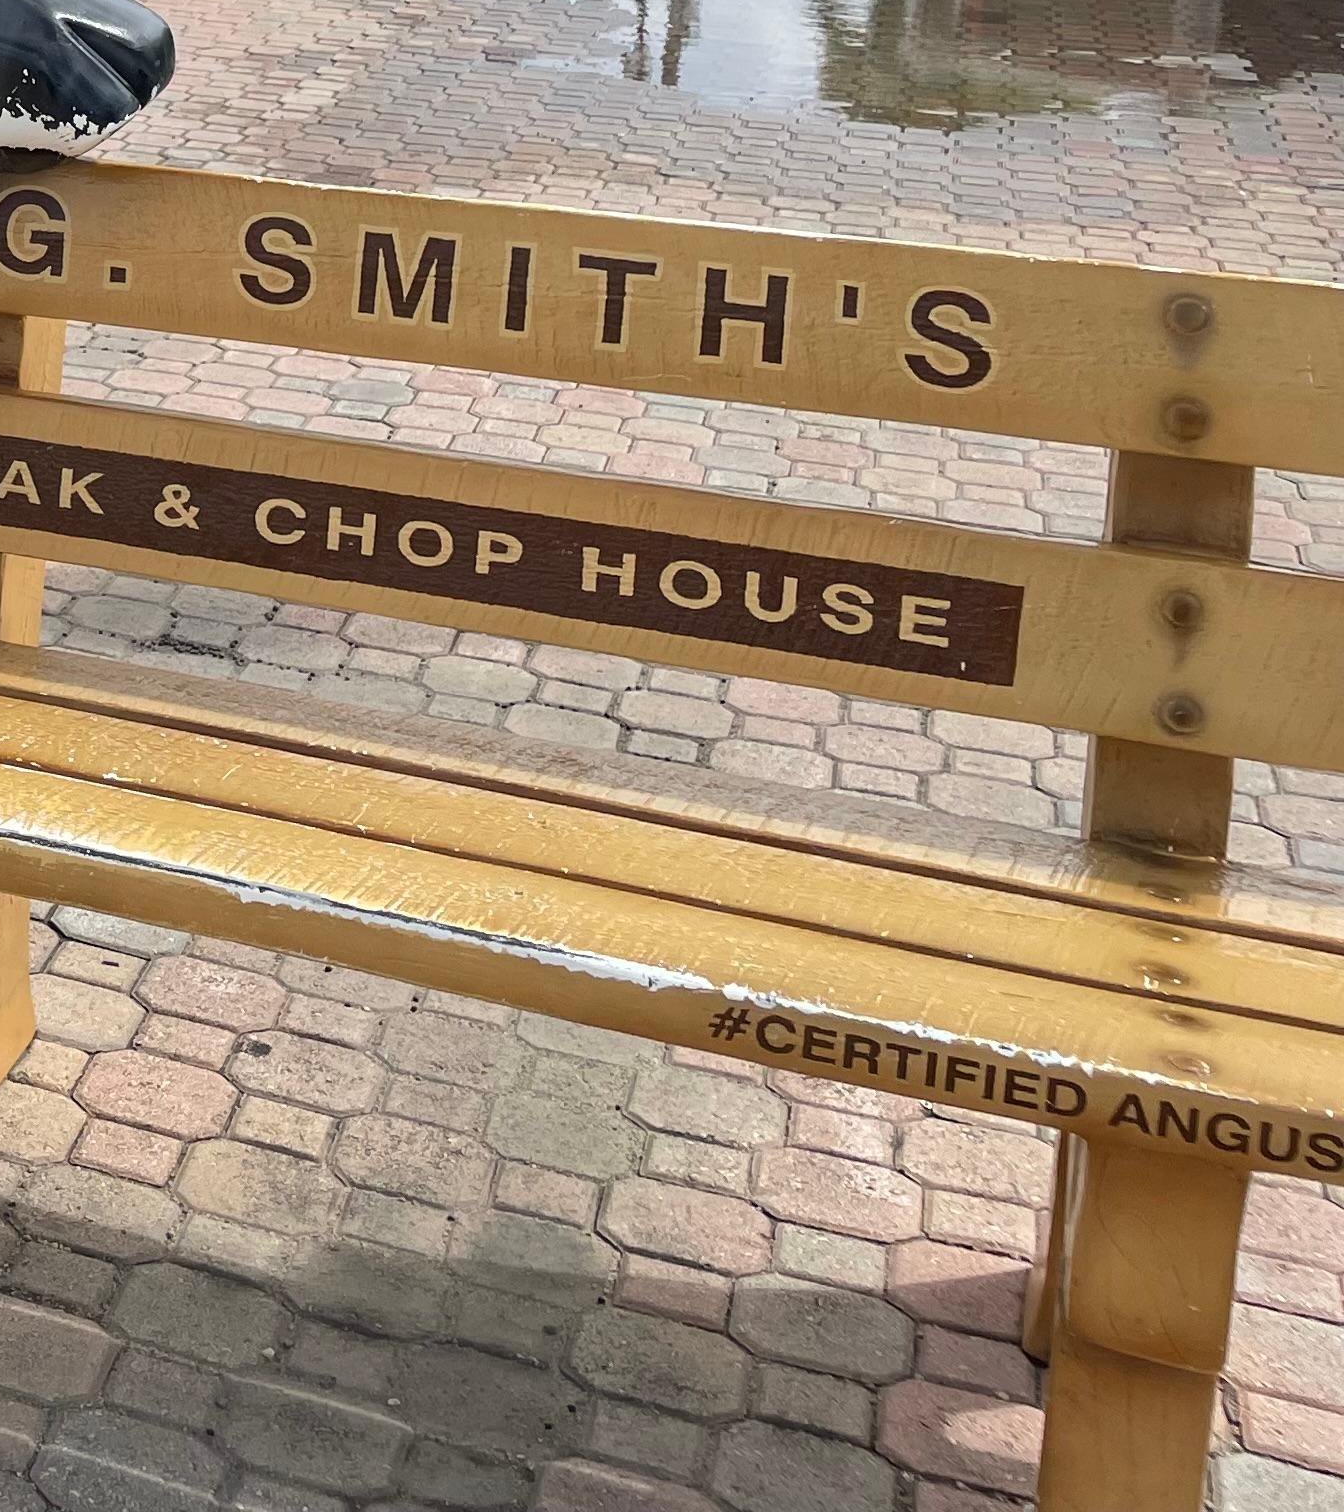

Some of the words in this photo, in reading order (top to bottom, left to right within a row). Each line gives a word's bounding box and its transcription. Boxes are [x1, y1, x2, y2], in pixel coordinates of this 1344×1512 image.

[241, 215, 995, 391] SMITH'S
[153, 479, 200, 530] &
[253, 498, 525, 576] CHOP
[580, 545, 954, 649] HOUSE
[707, 1006, 1089, 1118] #CERTIFIED
